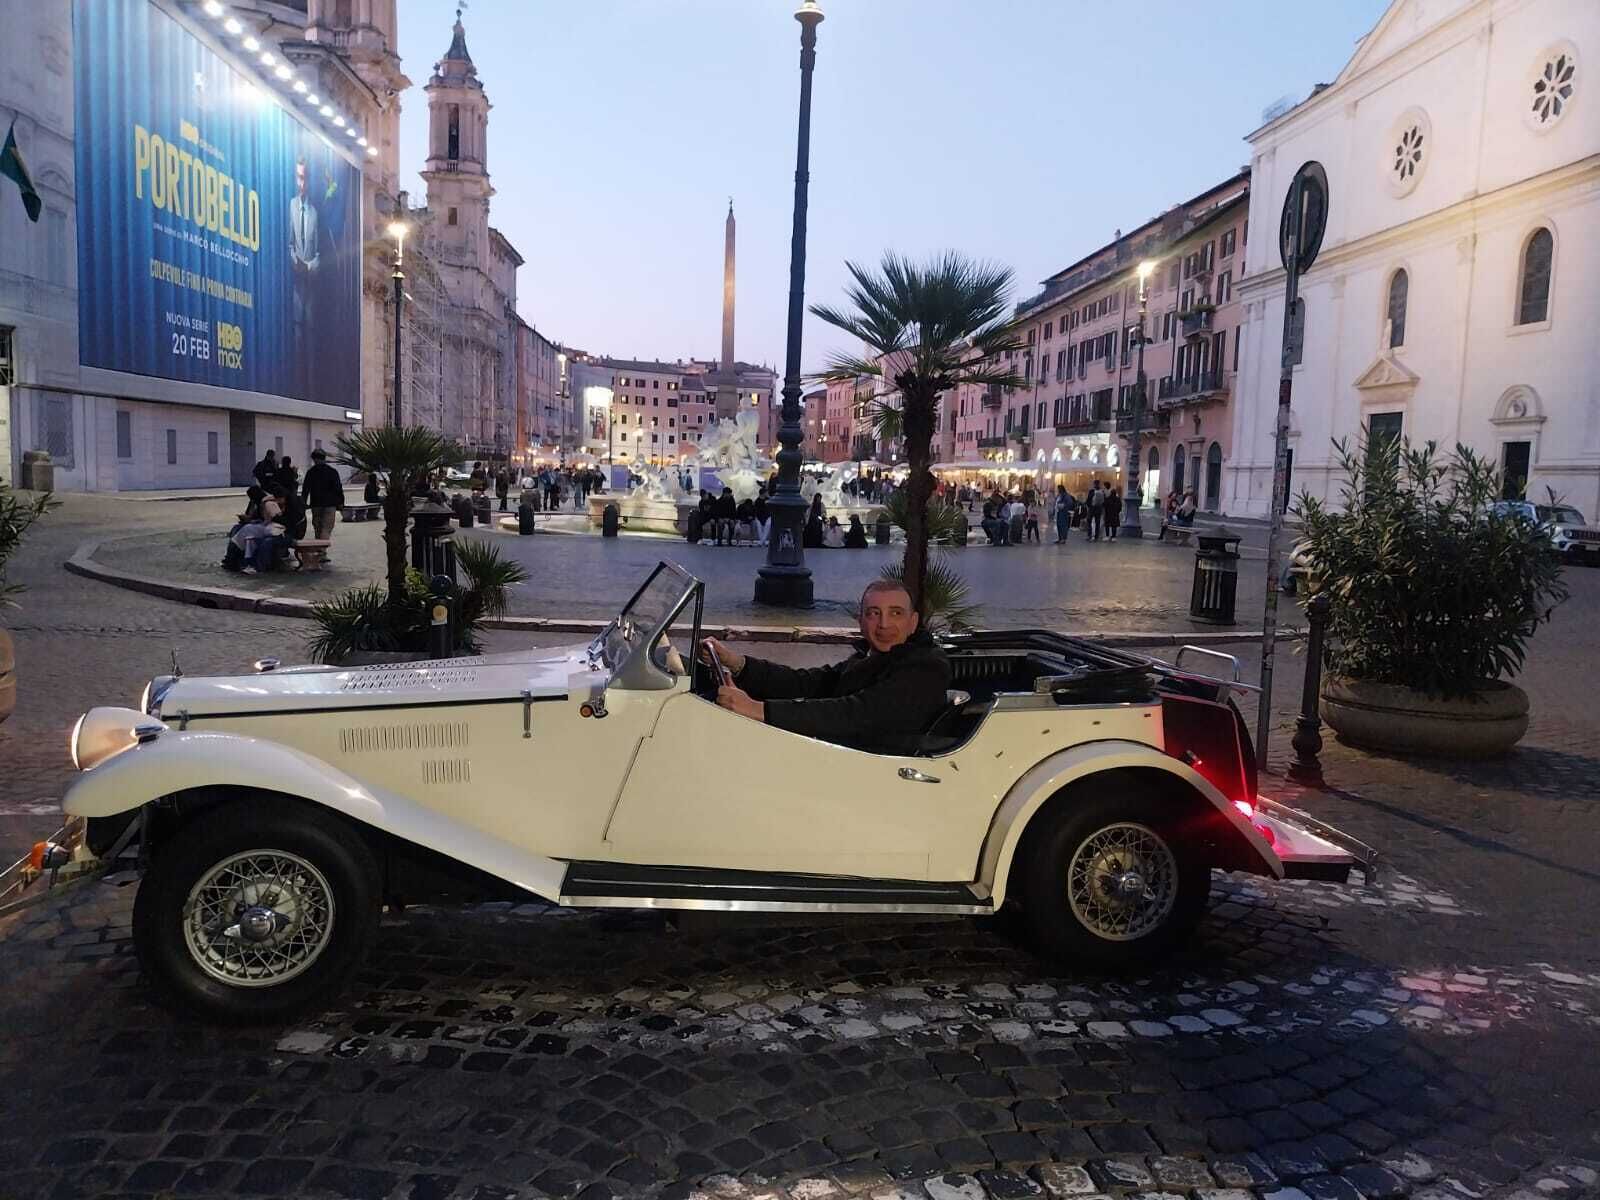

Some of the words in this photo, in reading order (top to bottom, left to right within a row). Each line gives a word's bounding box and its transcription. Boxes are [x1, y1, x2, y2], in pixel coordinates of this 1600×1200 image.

[135, 124, 259, 252] PORTOBELLO
[183, 230, 208, 249] MARCO
[211, 241, 249, 266] BELLOCCHIO
[150, 259, 185, 288] COLPEVOLE
[166, 311, 190, 328] NUOVA
[191, 318, 208, 333] SERIE
[217, 320, 242, 352] HBO
[172, 332, 187, 355] 20
[190, 336, 210, 360] FEB
[218, 349, 243, 370] max
